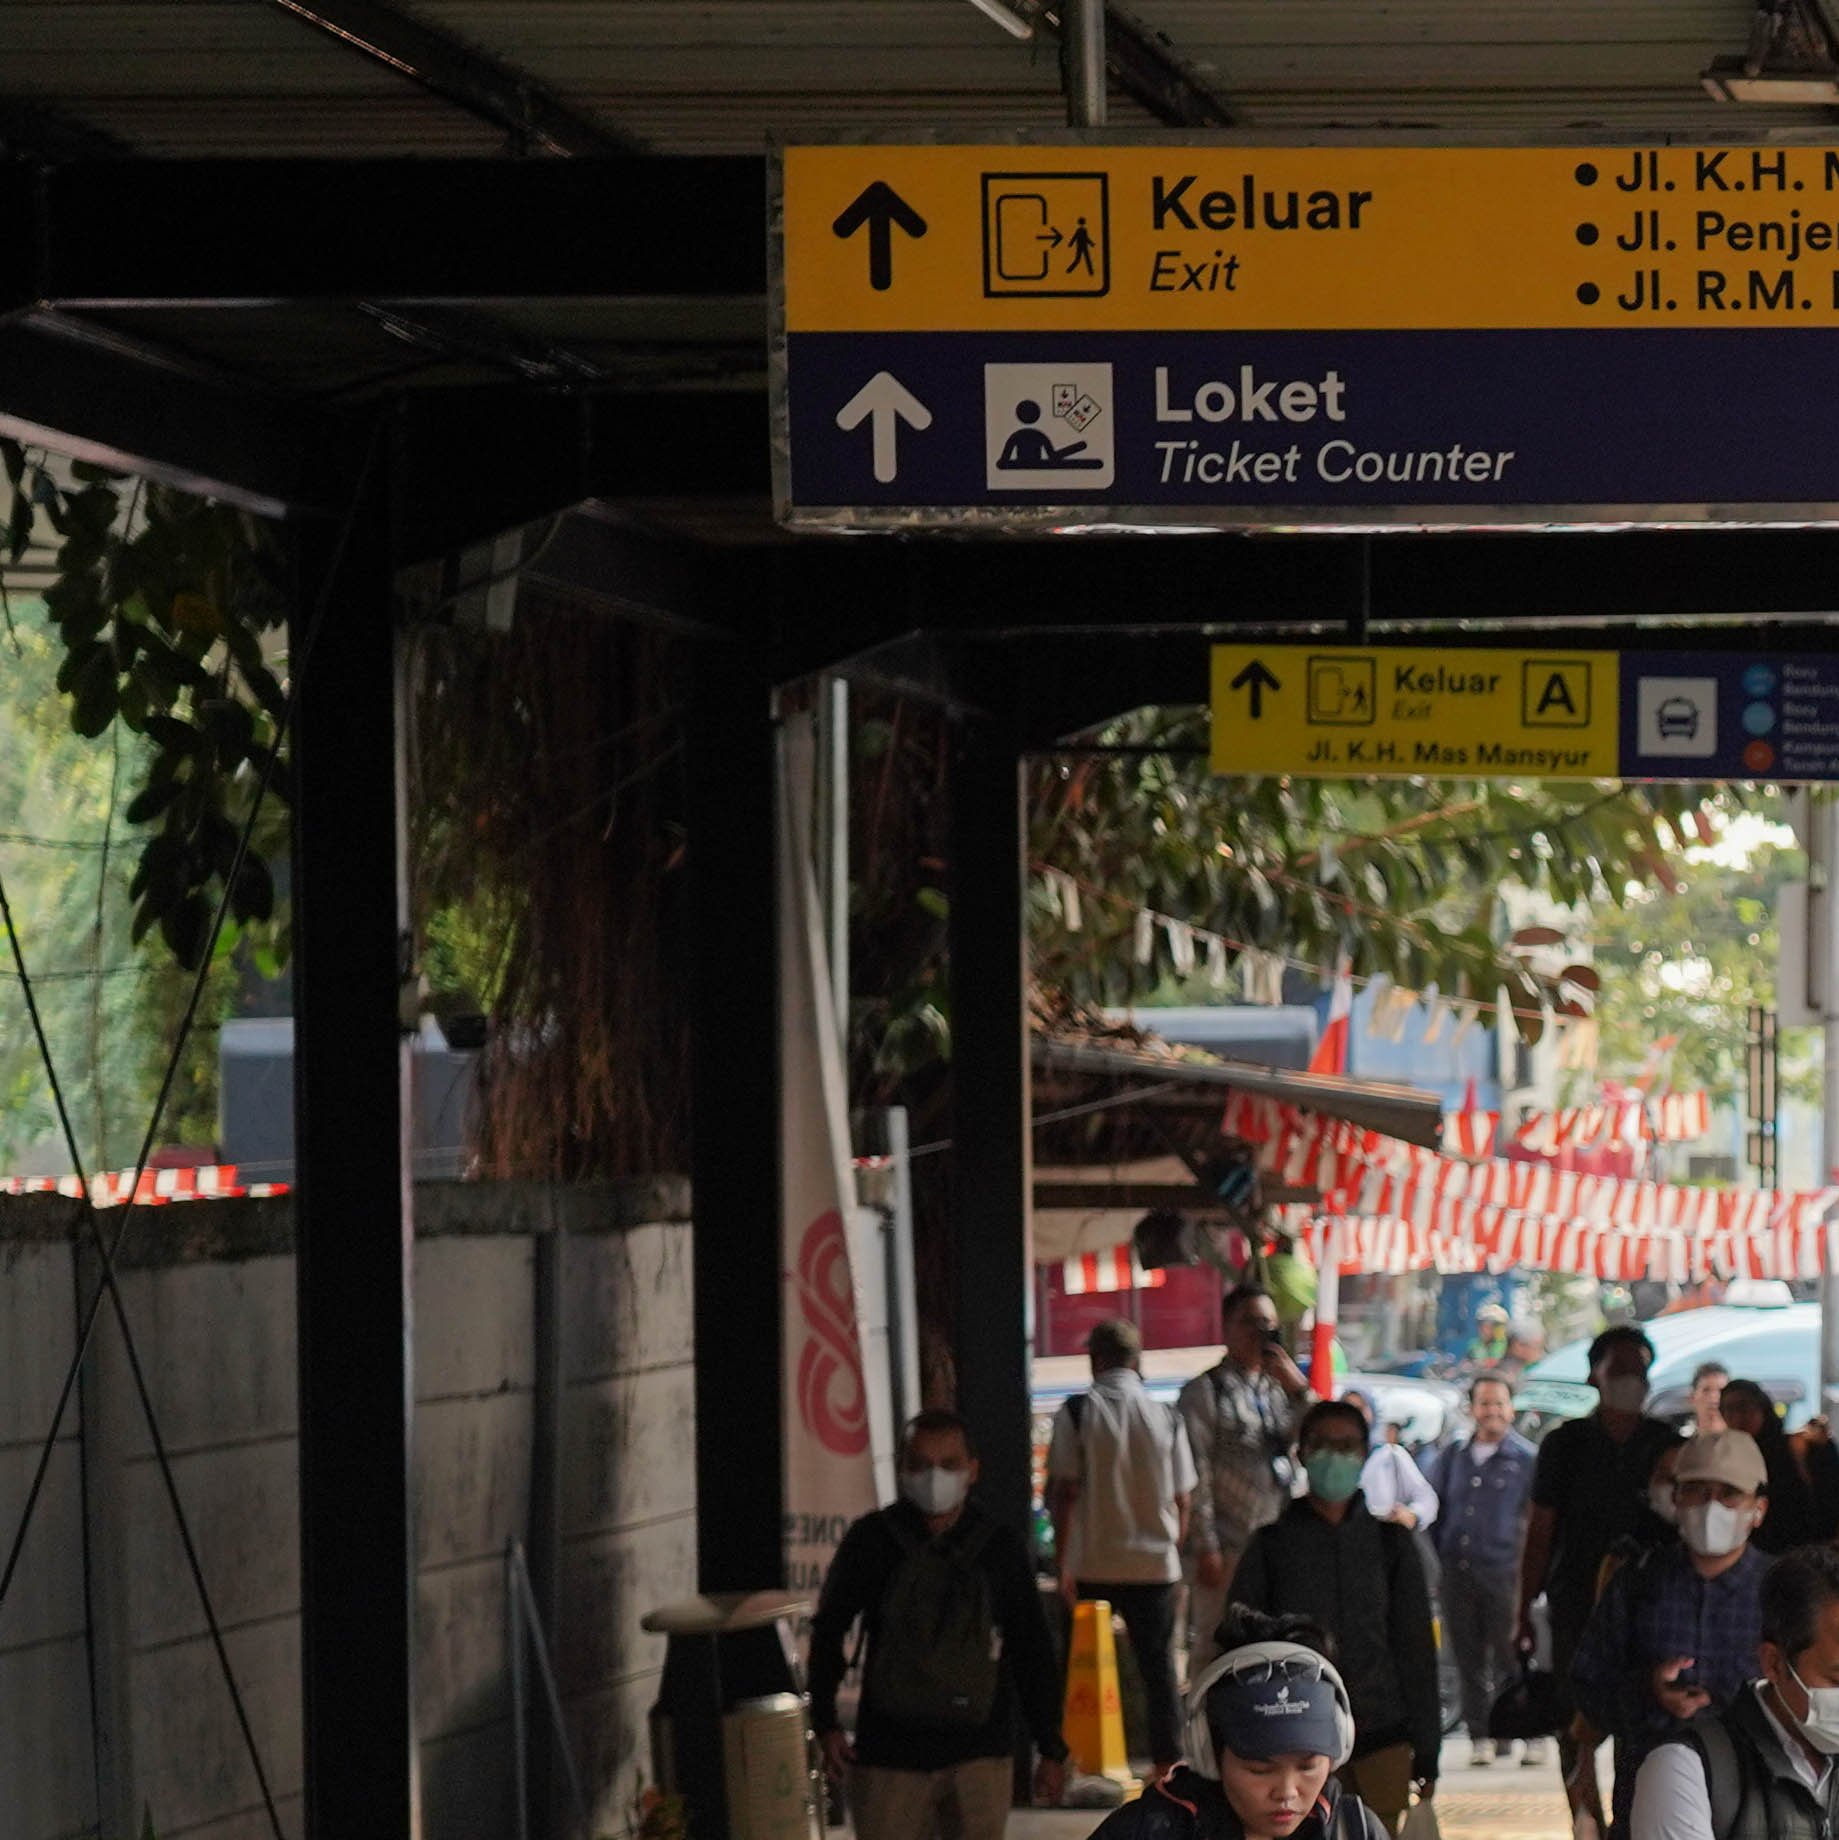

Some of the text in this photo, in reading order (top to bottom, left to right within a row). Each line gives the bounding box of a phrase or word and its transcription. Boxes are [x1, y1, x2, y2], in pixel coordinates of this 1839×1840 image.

[1616, 151, 1675, 192] Jl.
[1695, 152, 1804, 192] K.H.
[1151, 175, 1372, 231] Keluar
[1616, 211, 1677, 253] Jl.
[1149, 251, 1240, 293] Exit
[1617, 271, 1677, 312] Jl.
[1697, 270, 1812, 311] R.M.
[1155, 365, 1345, 424] Loket
[1155, 441, 1514, 484] Ticket Counter
[1395, 665, 1501, 694] Keluar
[1537, 672, 1576, 715] A
[1349, 743, 1404, 765] K.H.
[1414, 743, 1468, 765] Mas
[1477, 744, 1591, 771] Mansyur
